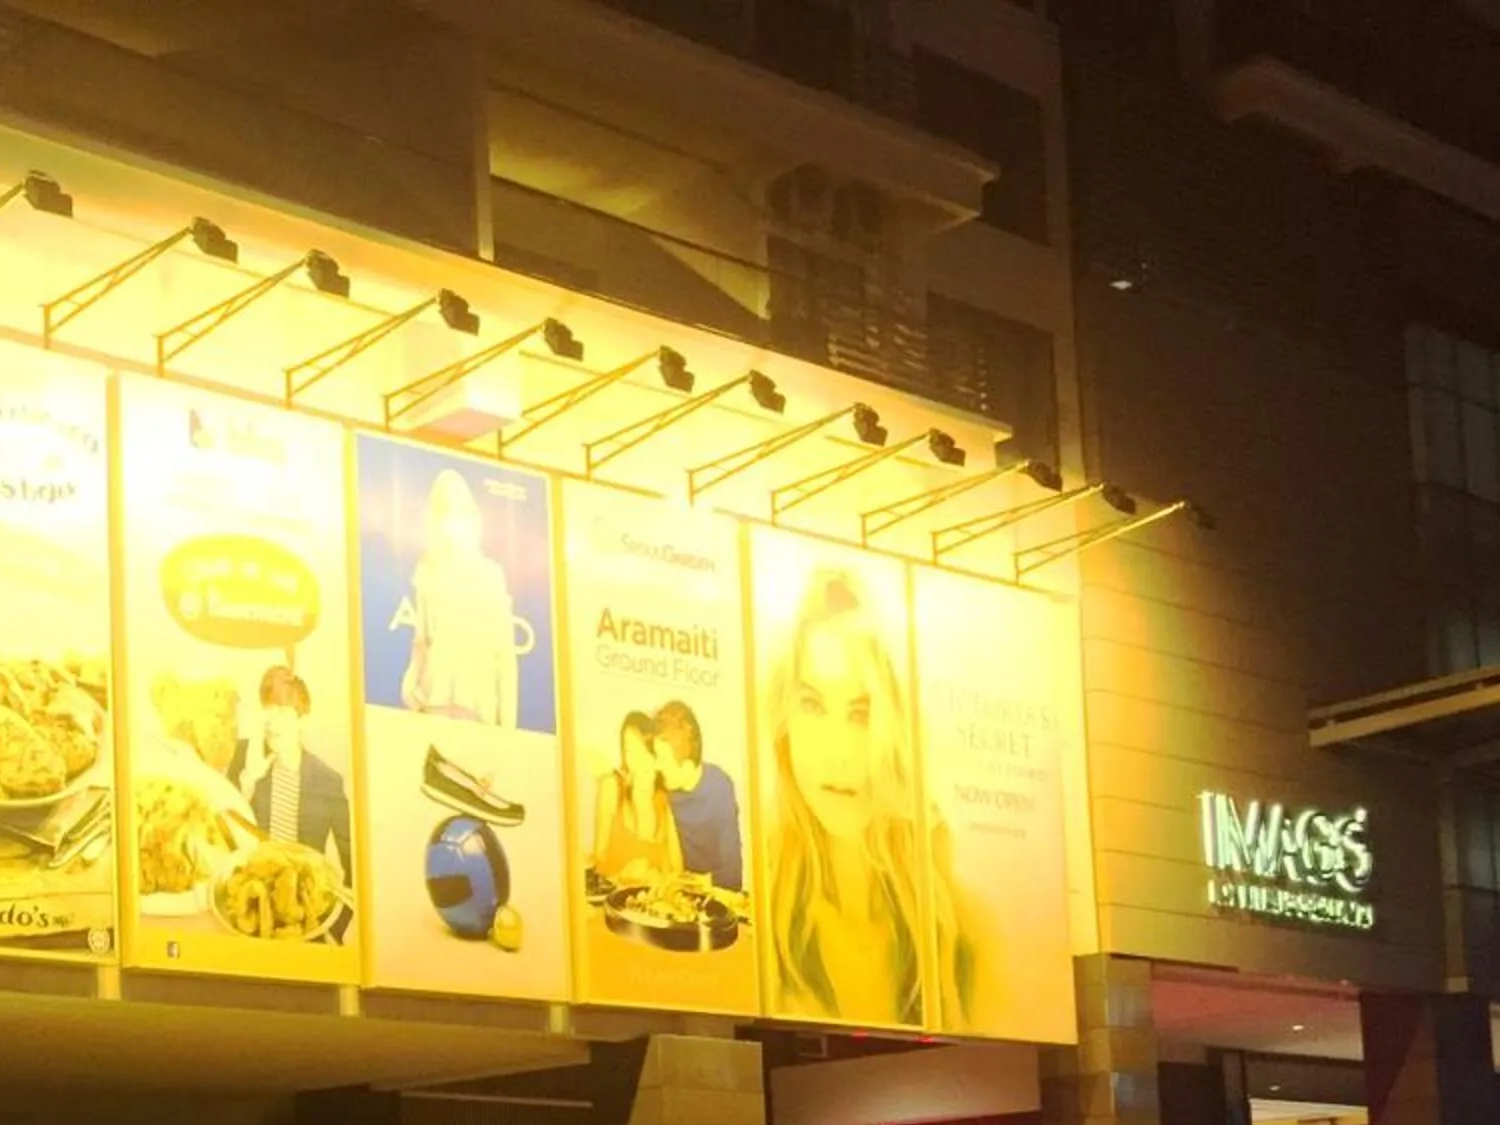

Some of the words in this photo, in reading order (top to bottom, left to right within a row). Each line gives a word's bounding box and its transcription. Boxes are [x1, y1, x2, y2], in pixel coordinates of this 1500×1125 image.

[596, 607, 718, 661] Aramaiti
[596, 644, 668, 678] Ground
[673, 658, 719, 688] Floor
